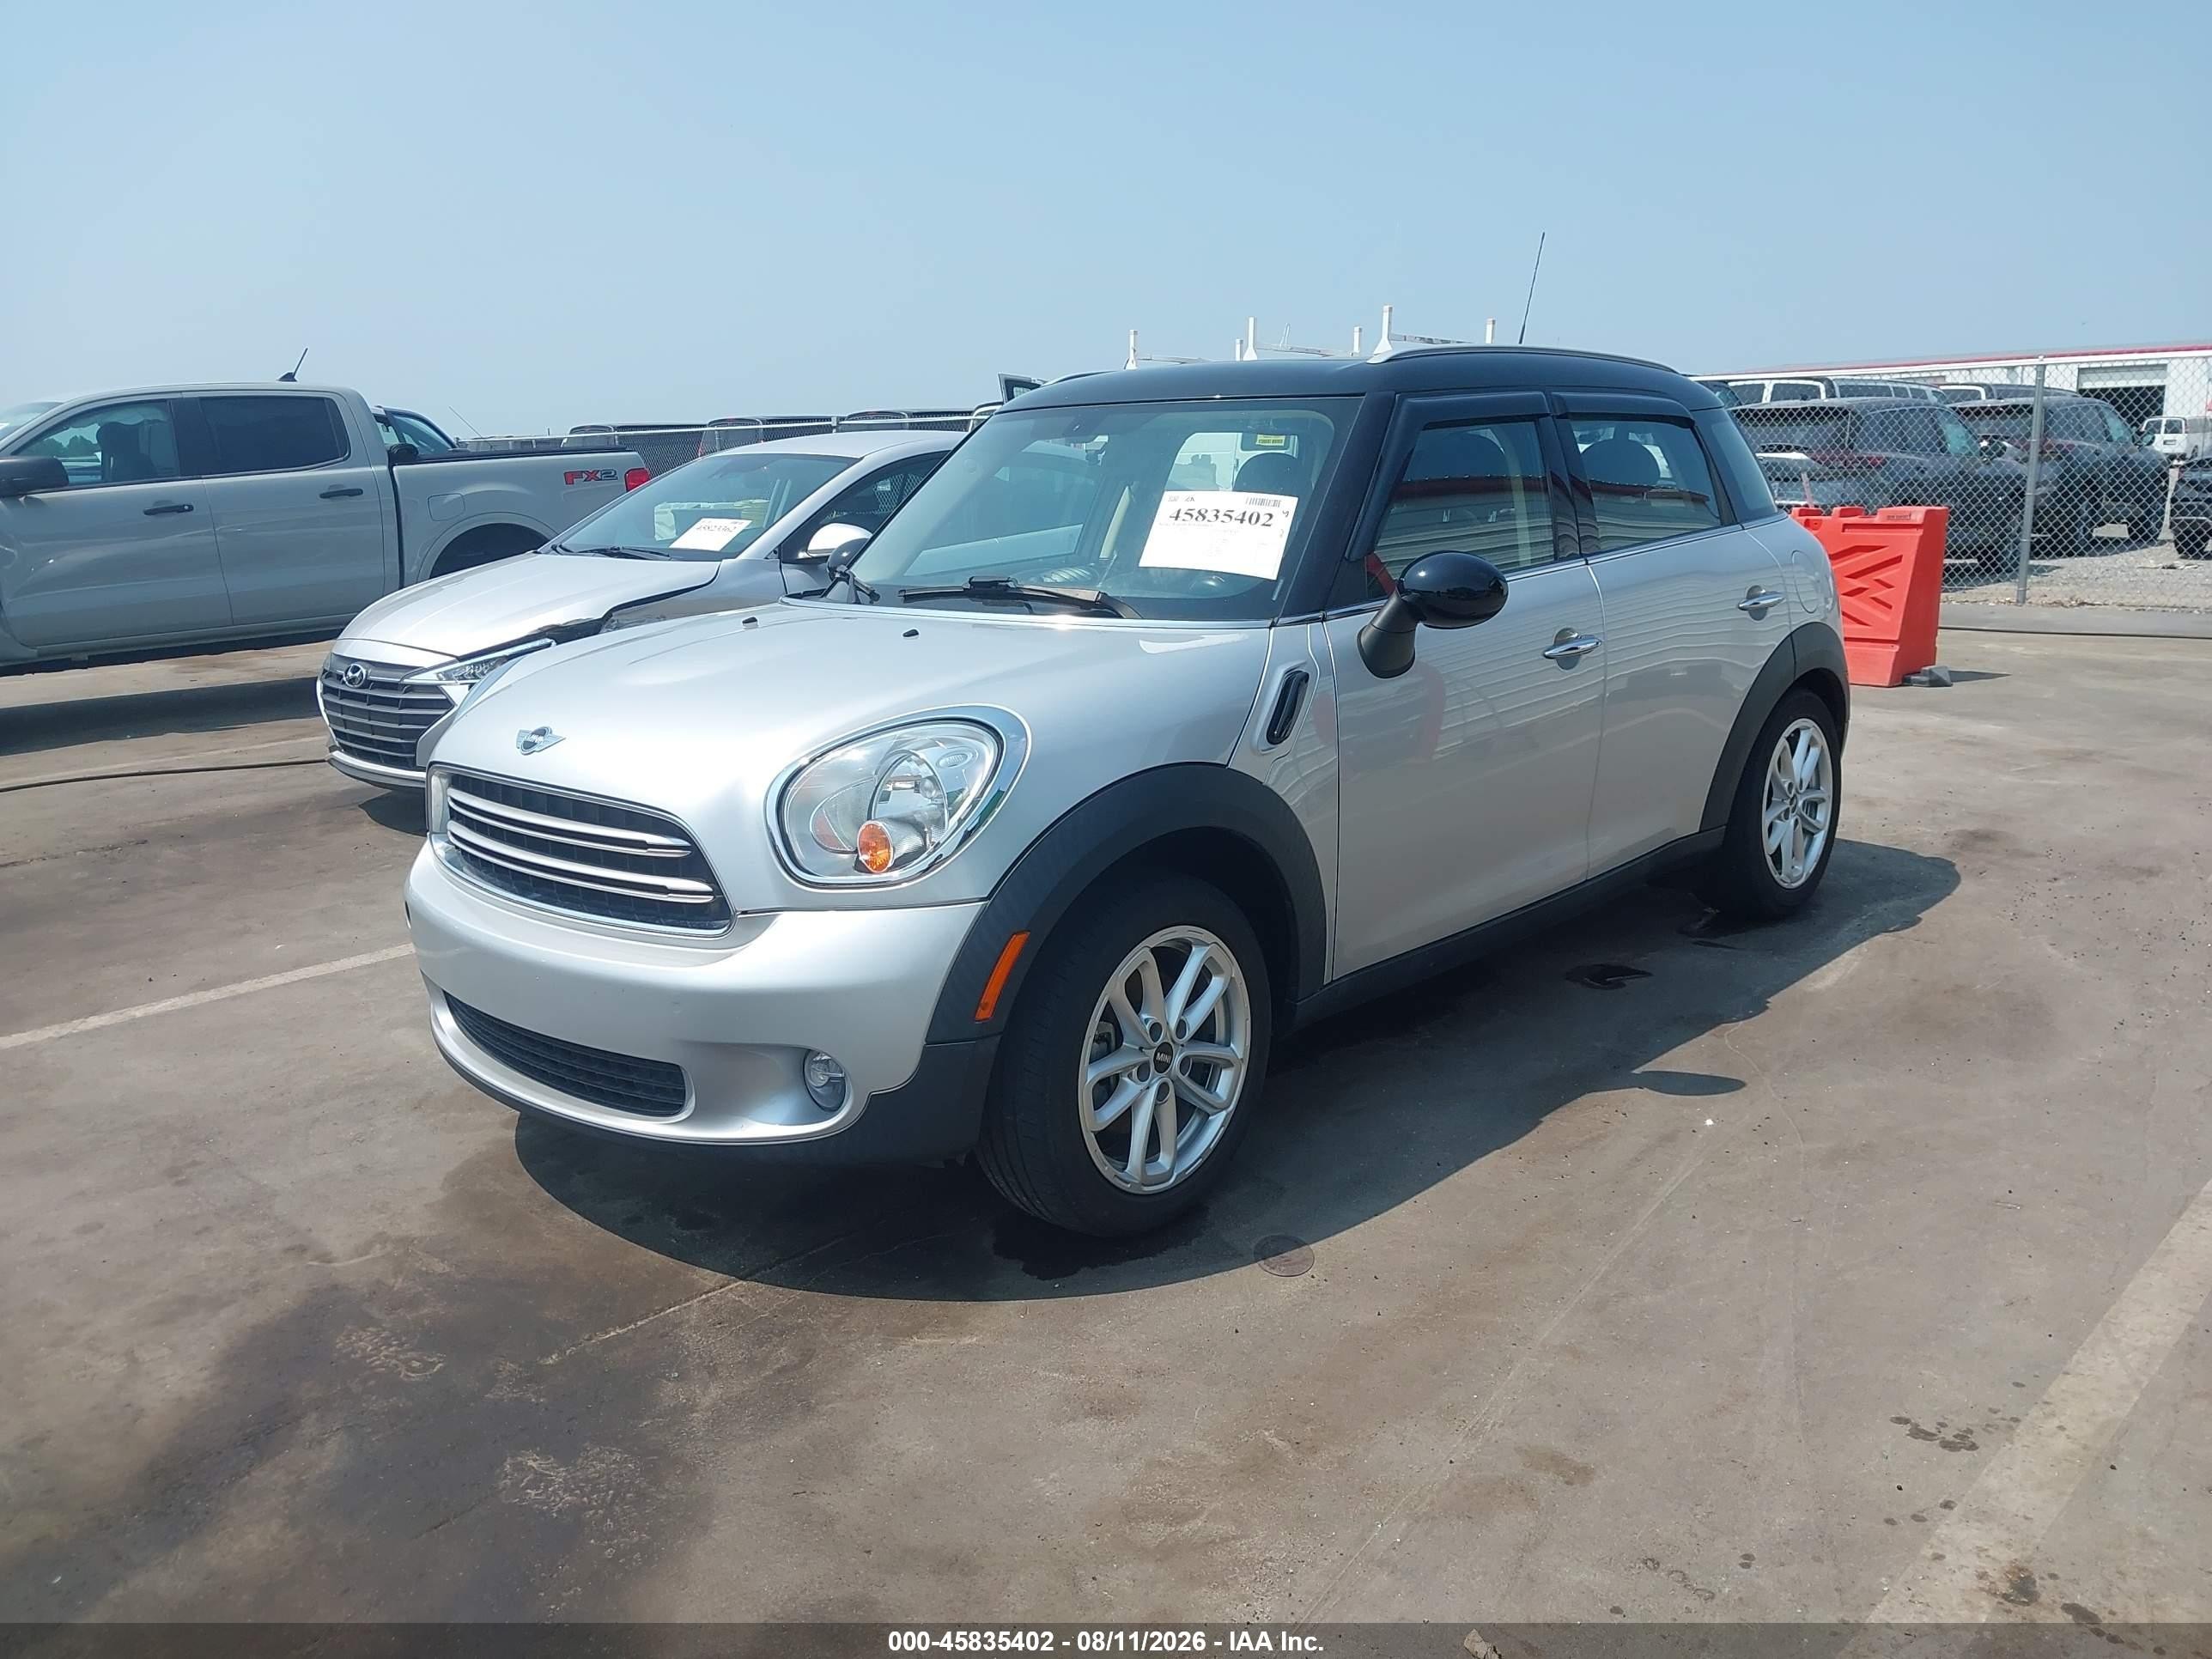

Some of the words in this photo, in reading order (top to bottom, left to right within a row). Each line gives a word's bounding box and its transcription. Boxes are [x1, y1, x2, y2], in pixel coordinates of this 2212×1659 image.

[563, 469, 618, 485] FX2
[1169, 507, 1274, 527] 45835402
[1156, 1052, 1172, 1064] MINI
